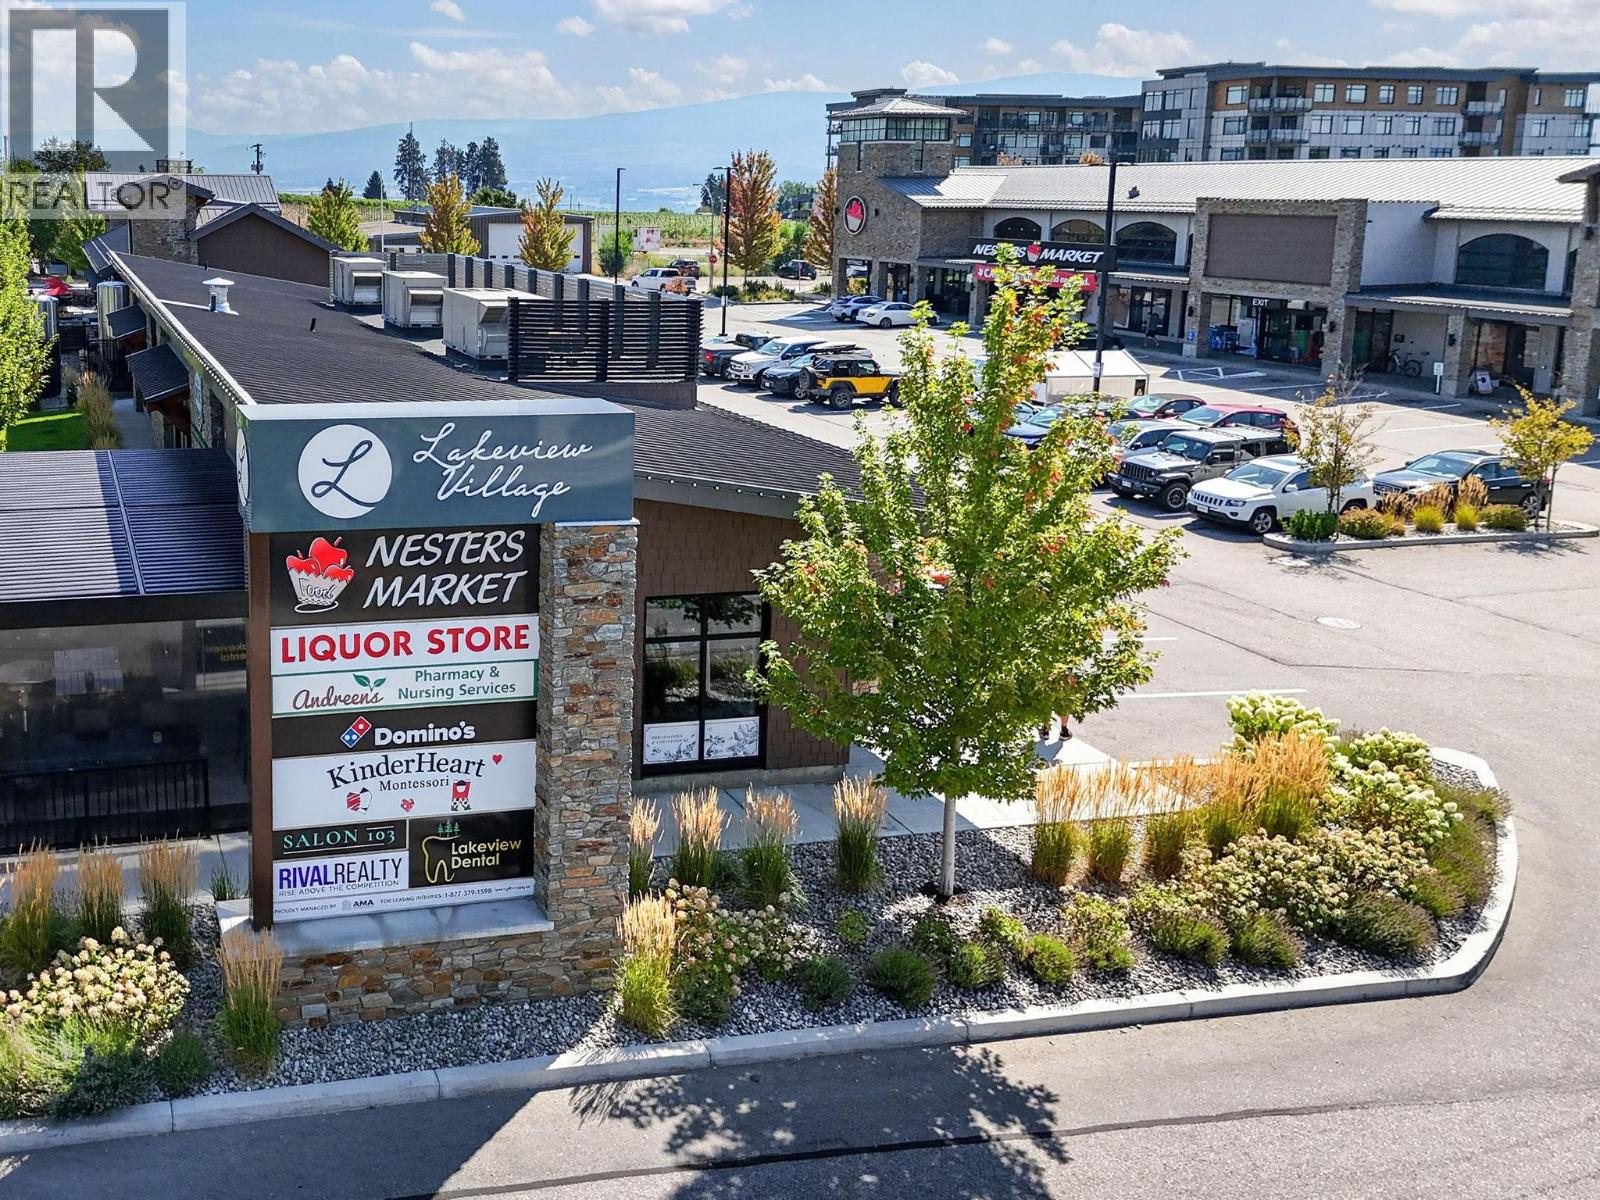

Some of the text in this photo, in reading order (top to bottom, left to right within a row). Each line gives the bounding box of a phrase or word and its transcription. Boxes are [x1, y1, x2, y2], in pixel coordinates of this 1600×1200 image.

[1039, 248, 1105, 264] MARKET
[1252, 298, 1270, 306] EXIT
[412, 421, 593, 469] Lakeview
[436, 464, 571, 519] Village
[364, 529, 528, 569] NESTERS
[299, 577, 336, 599] Food
[361, 569, 529, 610] MARKET
[281, 624, 530, 664] LIQUOR STORE
[414, 665, 500, 683] Pharmacy &
[397, 681, 517, 701] Nursing Services
[374, 720, 476, 747] Domino's
[325, 751, 487, 790] KinderHeart
[378, 775, 450, 792] Montessori
[282, 829, 396, 850] SALON 103
[451, 838, 523, 856] Lakeview
[451, 853, 500, 870] Dental
[278, 857, 403, 890] RIVALREALTY
[278, 880, 400, 897] RISE ABOVE THE COMPETITION
[352, 899, 375, 908] AMA
